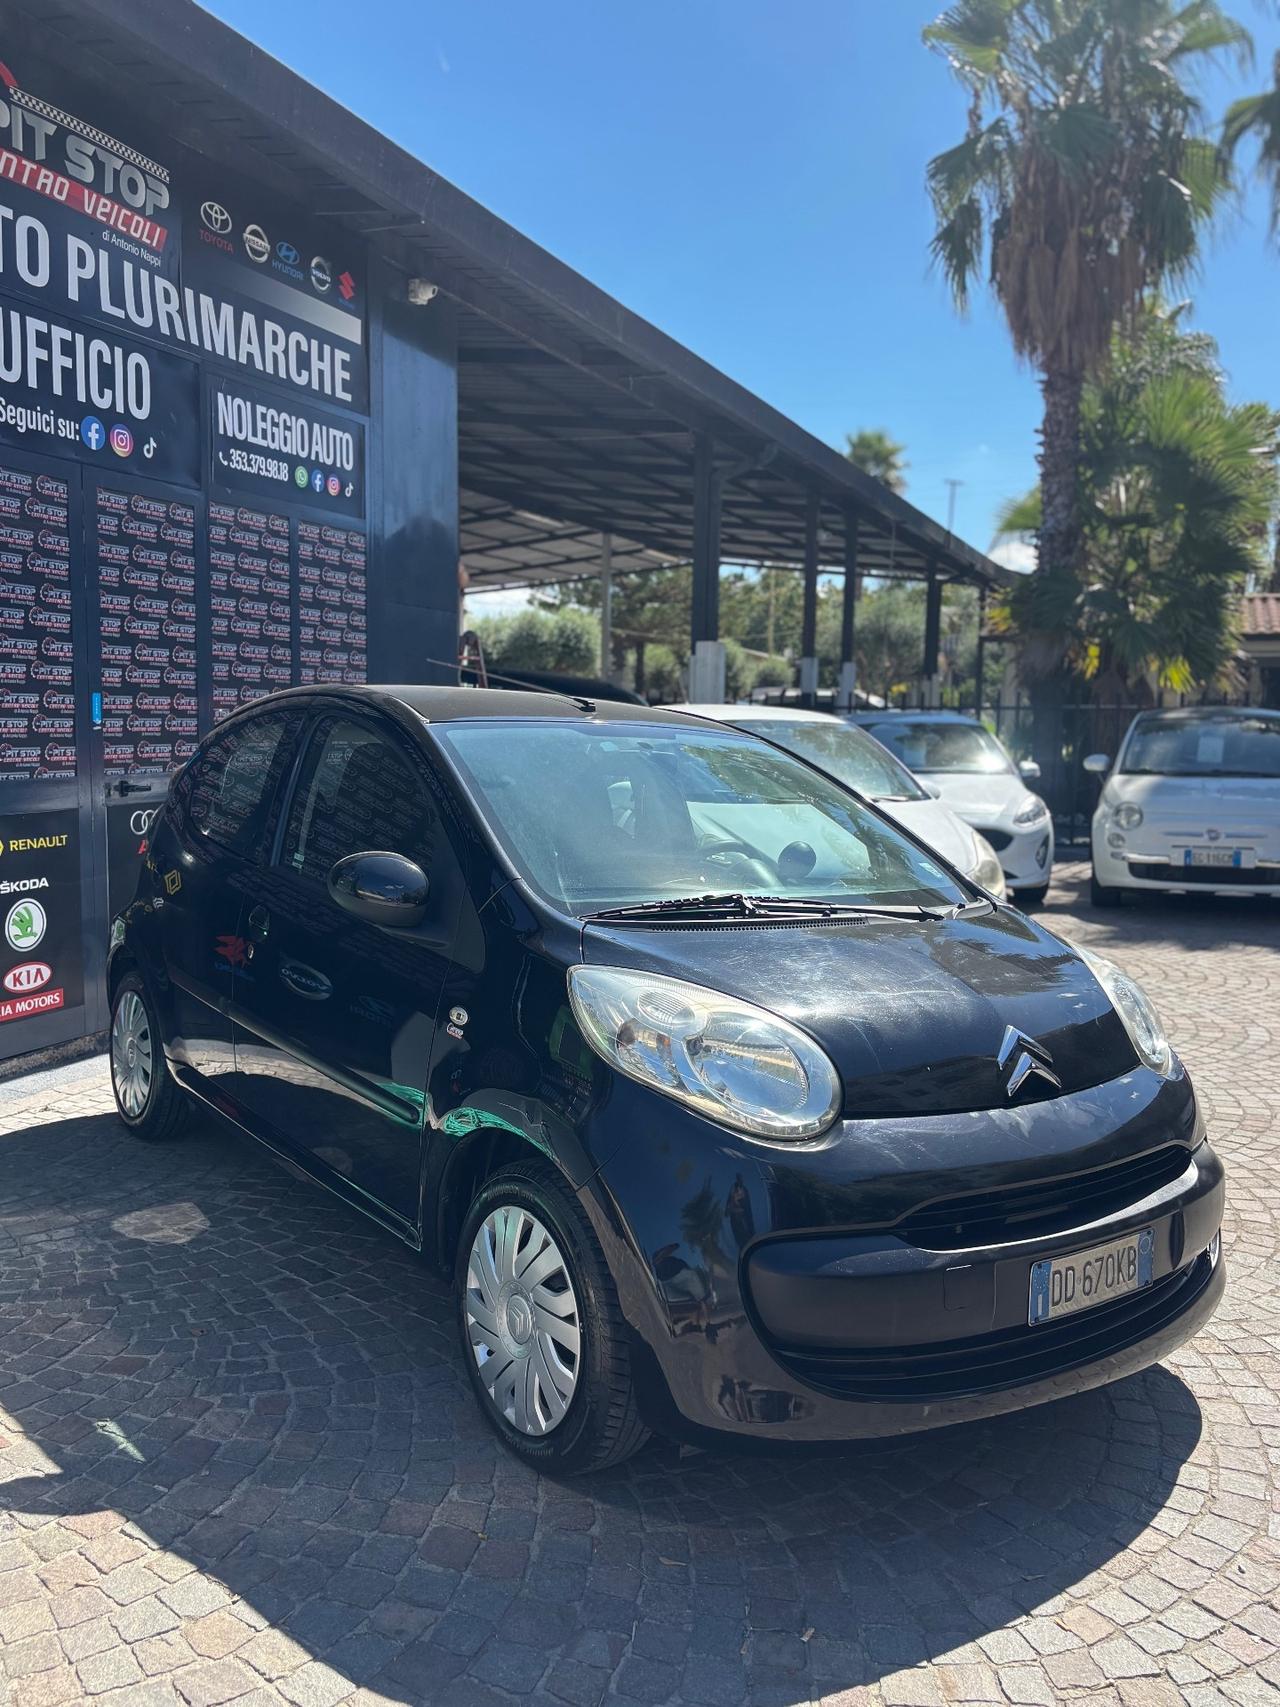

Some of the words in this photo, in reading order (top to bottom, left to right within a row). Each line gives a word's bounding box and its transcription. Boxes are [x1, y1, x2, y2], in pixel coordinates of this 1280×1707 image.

[64, 134, 169, 216] STOP
[83, 188, 161, 247] VEICOLI
[102, 229, 110, 240] di
[111, 232, 139, 255] Antonio
[141, 248, 161, 267] Nappi
[200, 229, 233, 255] TOYOTA
[245, 236, 269, 252] NISSAN
[272, 260, 304, 280] HYUNDAI
[313, 269, 331, 282] VOLVO
[67, 233, 352, 402] PLURIMARCHE
[0, 306, 151, 420] UFFICIO
[0, 397, 55, 434] Seguici
[58, 417, 80, 441] su:
[217, 392, 309, 458] NOLEGGIO
[310, 422, 354, 471] AUTO
[229, 448, 289, 481] 353.379.98.18
[9, 834, 68, 852] RENAULT
[0, 877, 49, 894] ŠKODA
[12, 967, 44, 988] KIA
[0, 1004, 13, 1017] IA
[15, 992, 60, 1013] MOTORS
